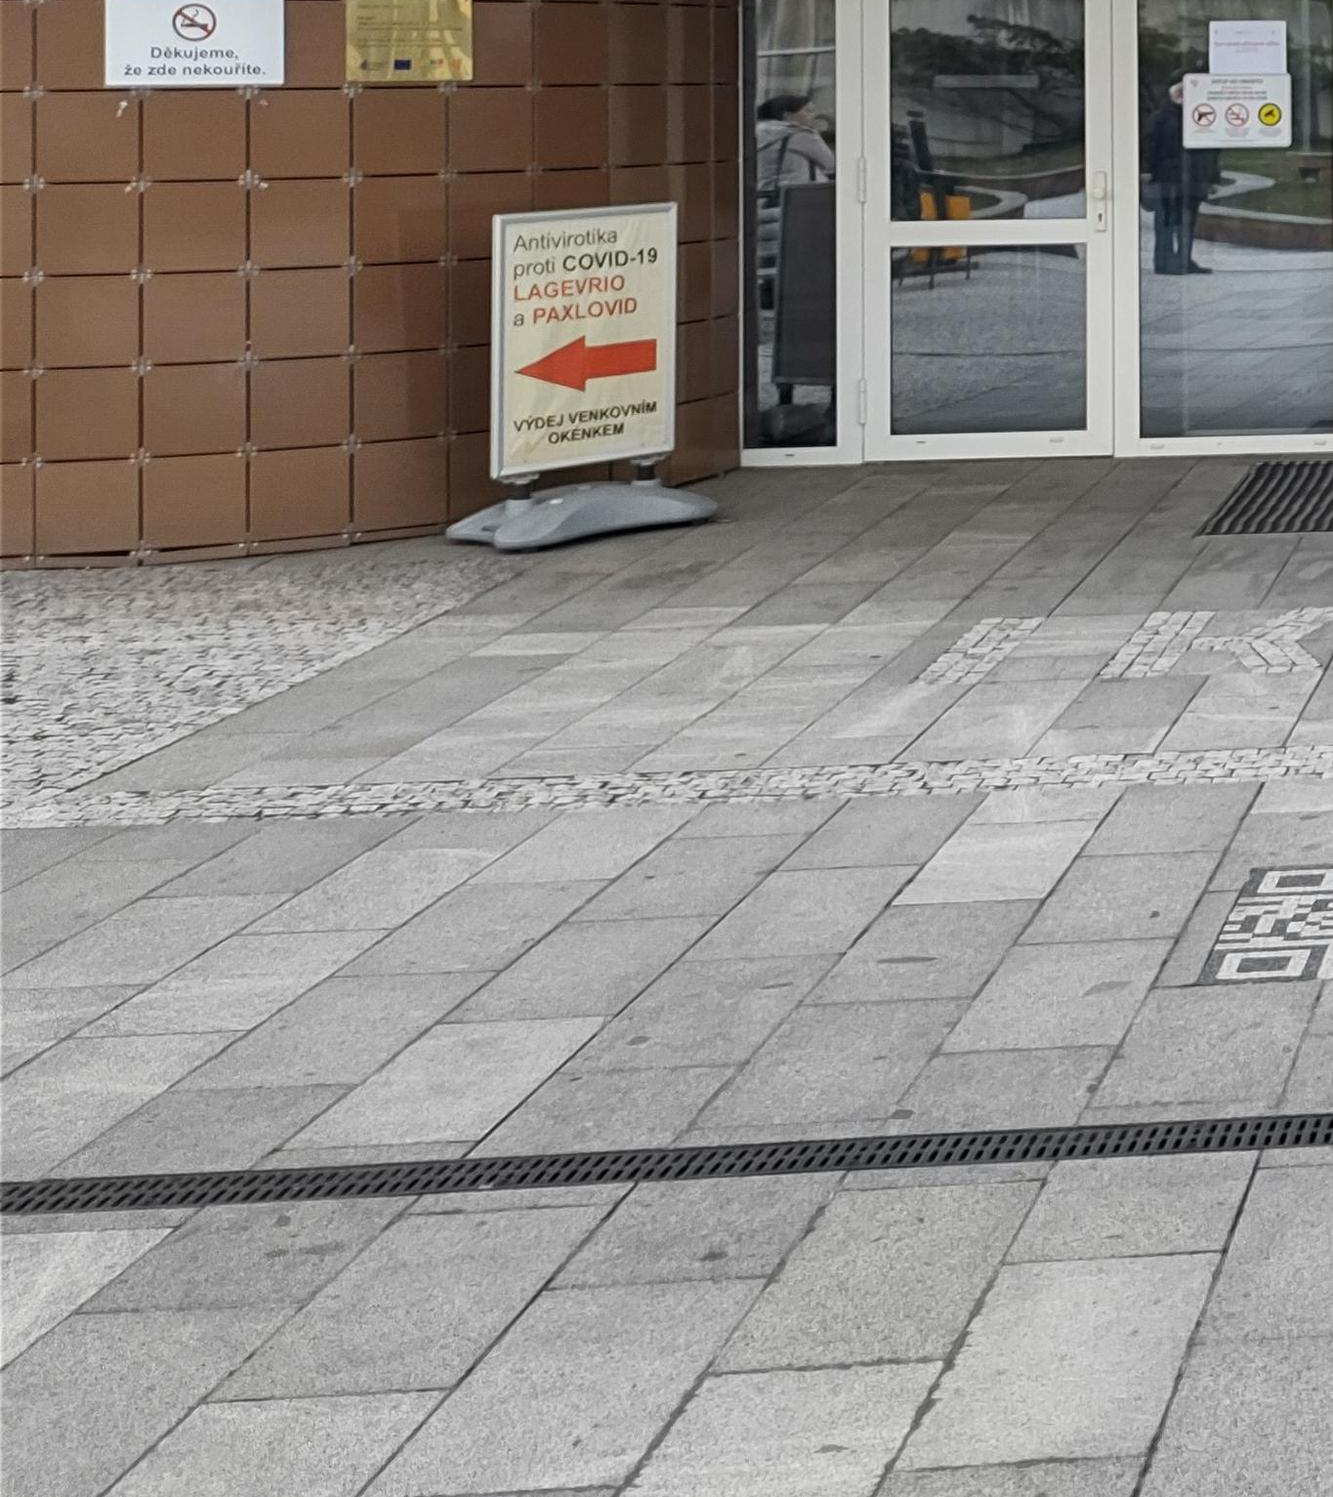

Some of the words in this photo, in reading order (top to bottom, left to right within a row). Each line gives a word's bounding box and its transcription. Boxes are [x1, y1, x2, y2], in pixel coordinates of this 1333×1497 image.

[150, 46, 239, 62] Děkujeme,
[123, 63, 142, 76] že
[147, 63, 177, 76] zde
[182, 63, 266, 76] nekouříte.
[513, 228, 618, 253] Antivirotika
[513, 255, 556, 280] proti
[562, 247, 659, 272] COVID-19
[513, 274, 626, 301] LAGEVRIO
[513, 312, 525, 327] a
[532, 297, 638, 324] PAXLOVID
[513, 415, 565, 432] VÝDEJ
[567, 399, 658, 424] VENKOVNÍM
